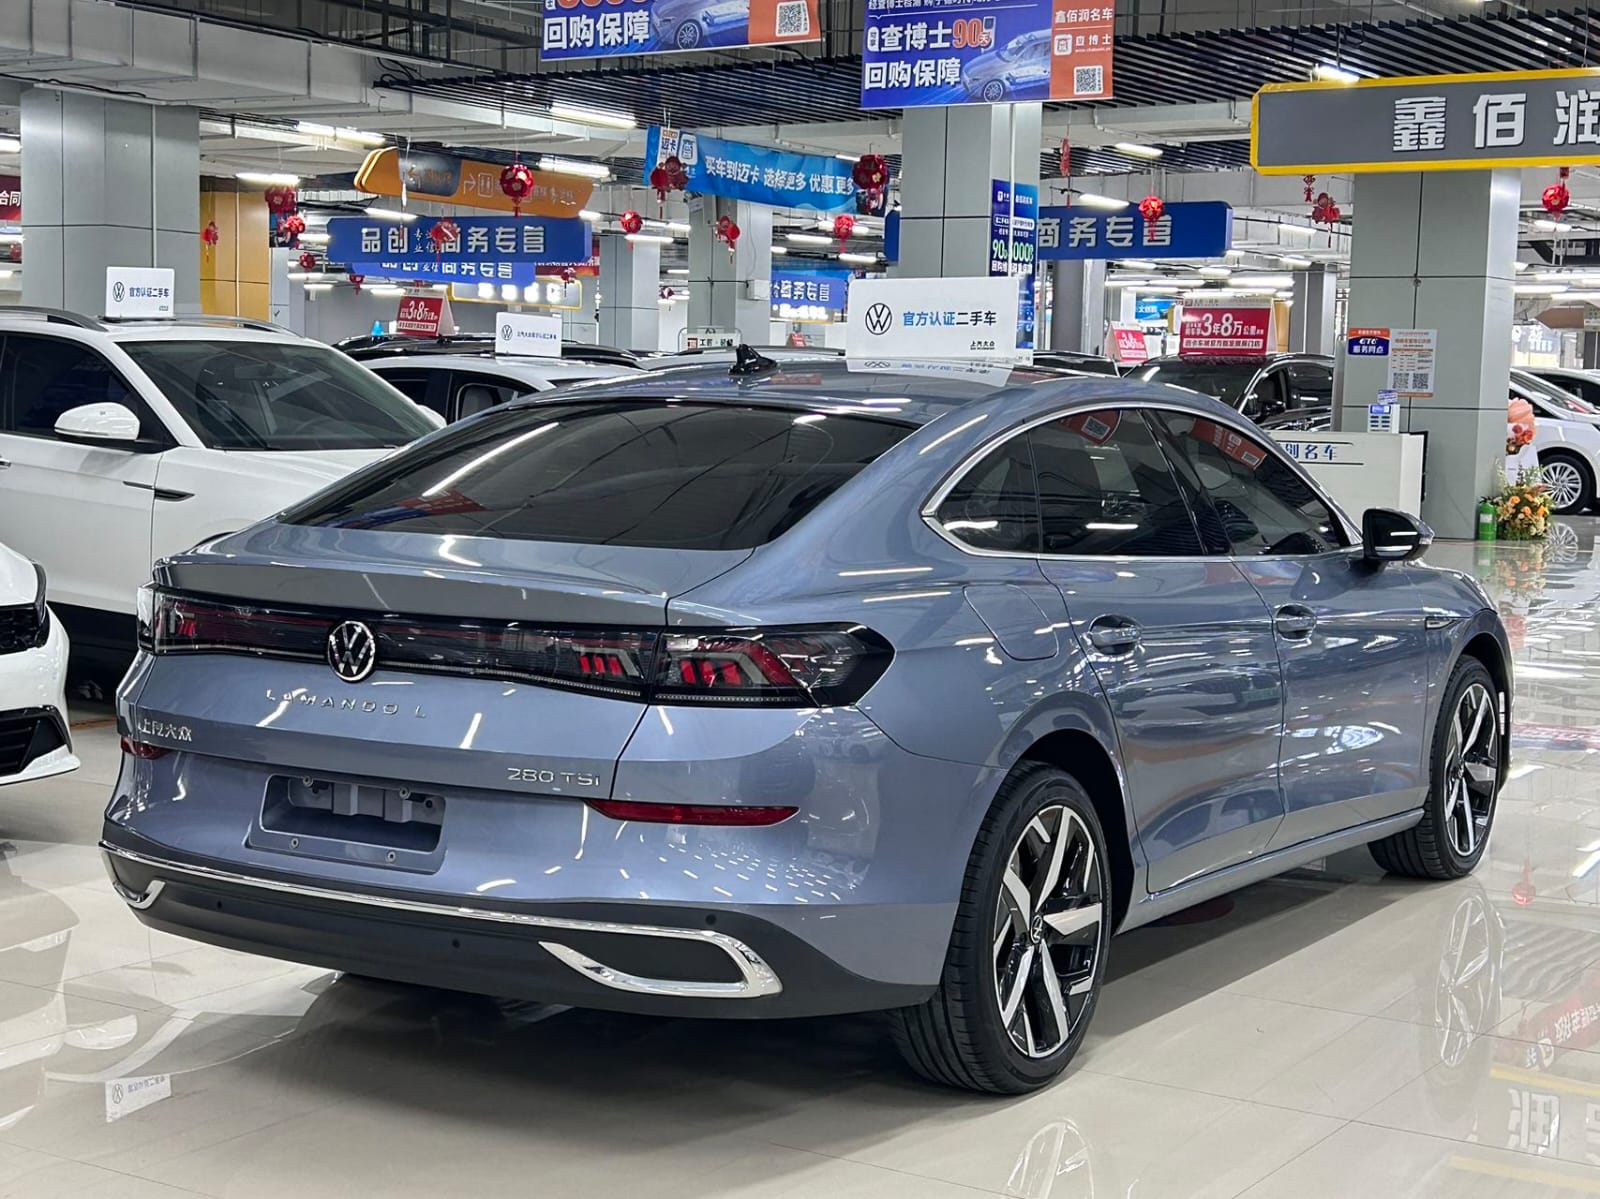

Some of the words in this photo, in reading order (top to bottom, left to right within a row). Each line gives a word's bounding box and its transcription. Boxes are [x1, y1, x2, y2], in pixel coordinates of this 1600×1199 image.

[1055, 7, 1112, 23] 鑫佰润名车
[543, 10, 649, 50] 回购保障
[864, 58, 961, 89] 回购保障
[1392, 88, 1600, 152] 鑫佰润
[704, 155, 760, 184] 买车到迈卡
[763, 167, 806, 191] 选择更多
[809, 172, 854, 195] 优惠更多
[361, 227, 408, 253] 品创
[902, 310, 997, 326] 官方认证二手车
[414, 704, 429, 719] L
[507, 767, 554, 783] 280
